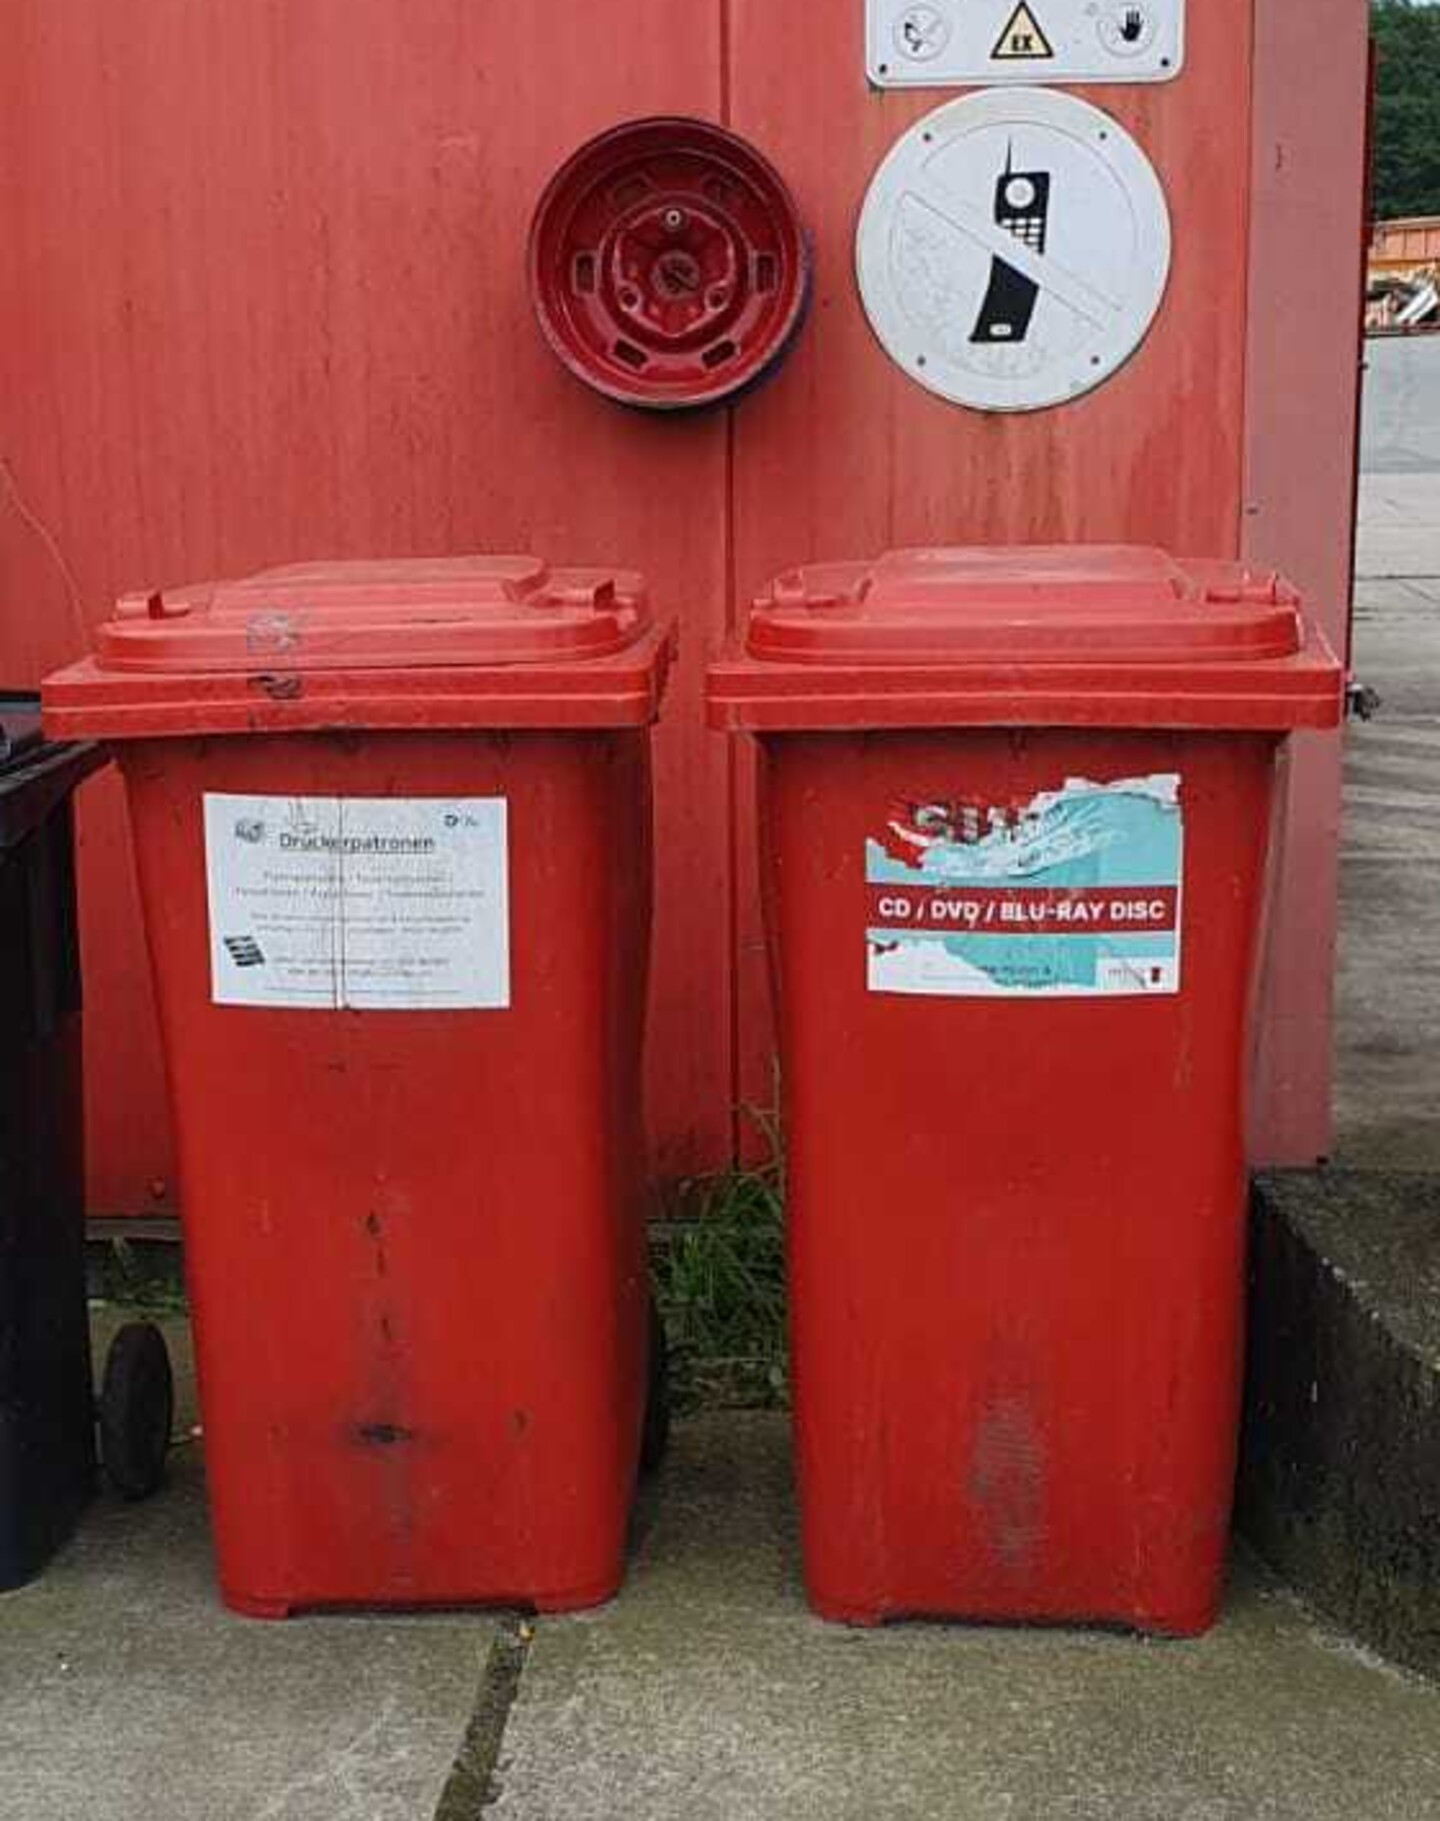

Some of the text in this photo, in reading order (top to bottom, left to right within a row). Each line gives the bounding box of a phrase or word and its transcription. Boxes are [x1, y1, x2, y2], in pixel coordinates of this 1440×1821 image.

[1012, 35, 1034, 51] EX
[278, 832, 435, 853] Druckerpatronen
[878, 898, 1166, 921] CD / DVD / BLU-RAY DISC
